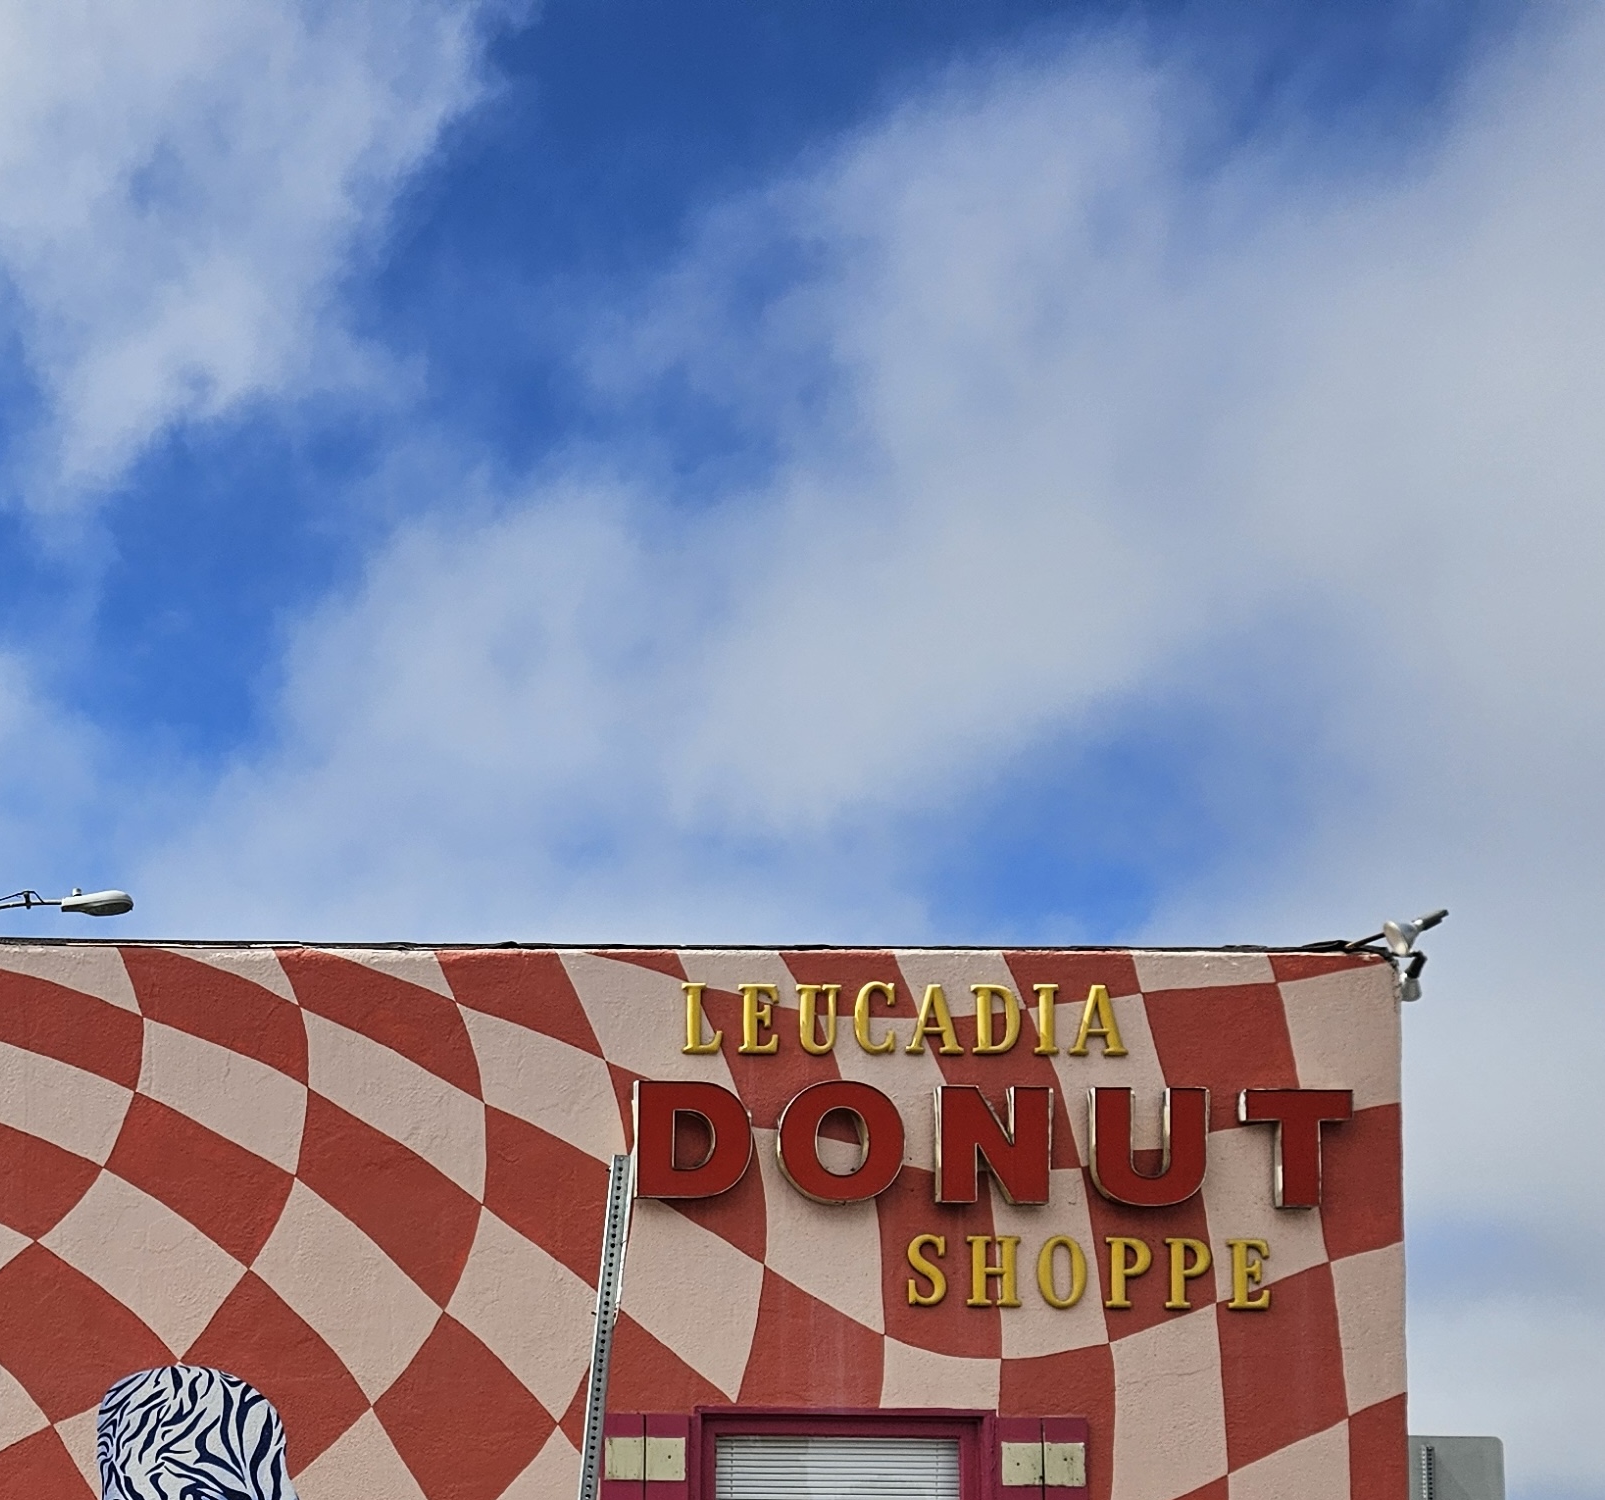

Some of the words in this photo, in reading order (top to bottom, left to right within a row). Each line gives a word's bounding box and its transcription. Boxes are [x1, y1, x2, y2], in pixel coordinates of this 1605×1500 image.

[680, 980, 1129, 1057] LEUCADIA
[633, 1079, 1354, 1209] DONUT
[907, 1233, 1272, 1312] SHOPPE
